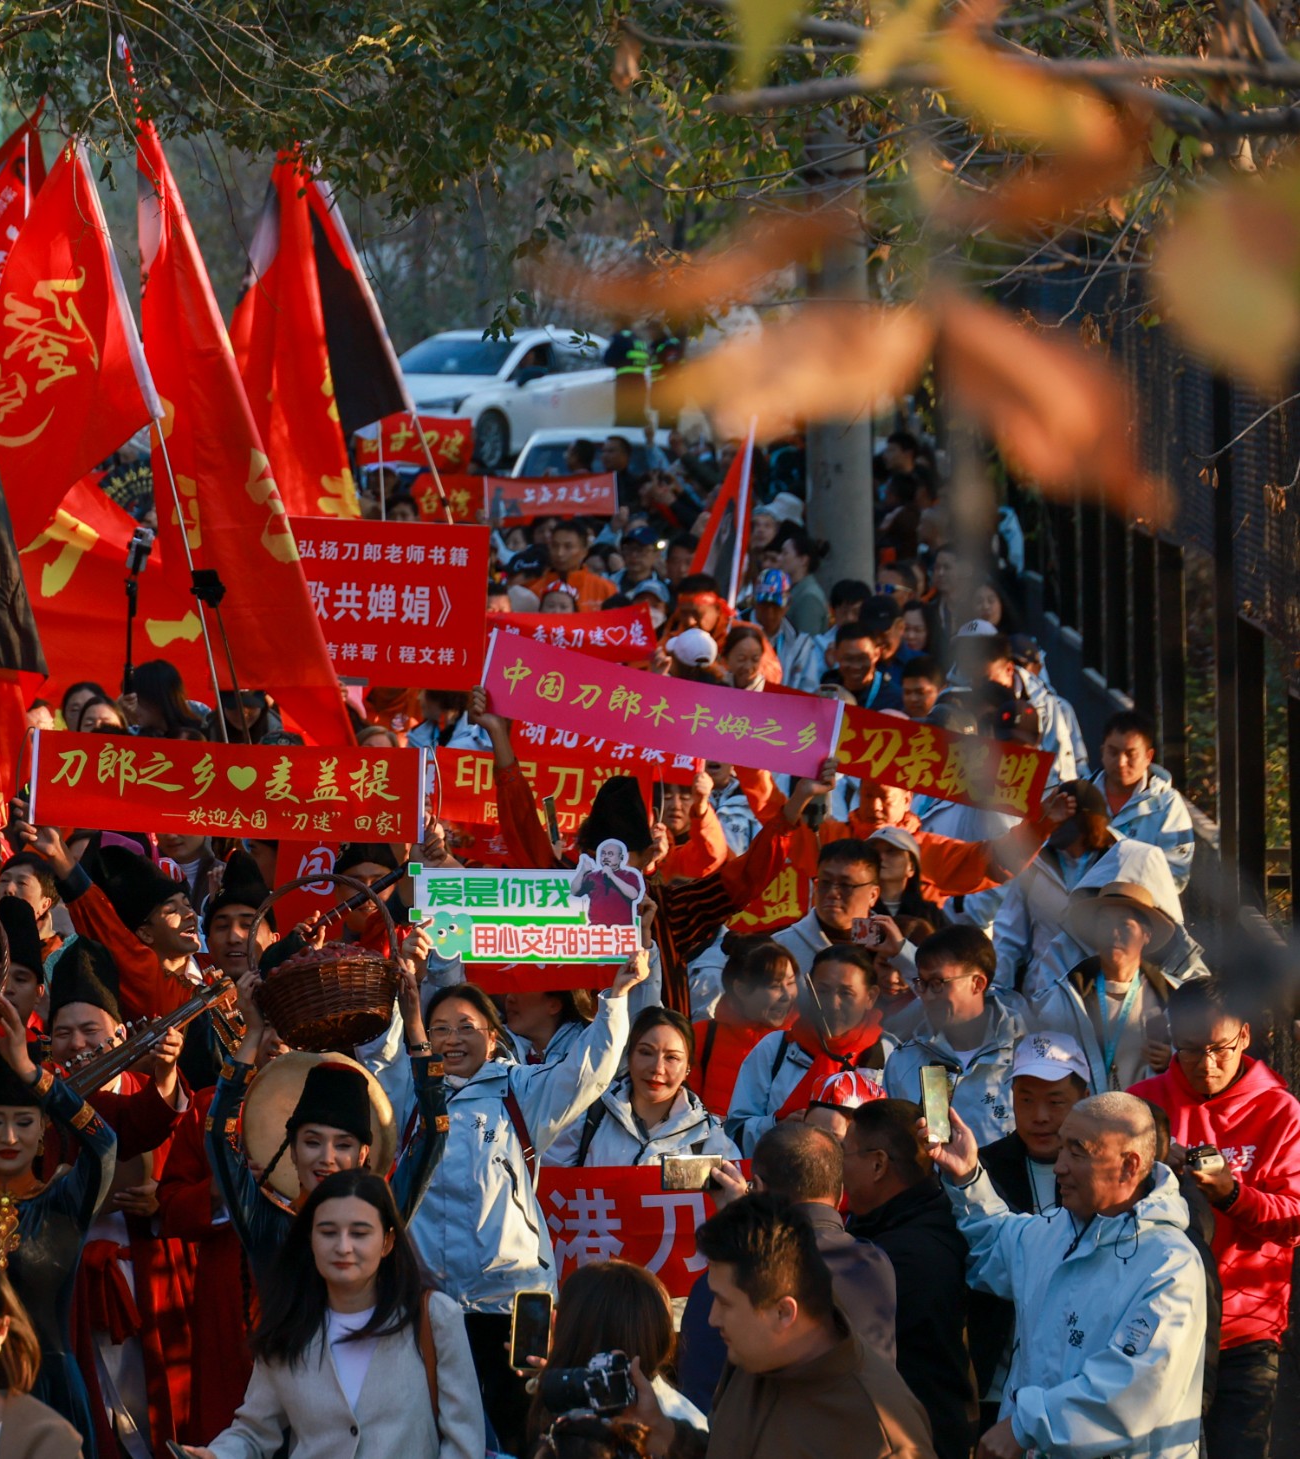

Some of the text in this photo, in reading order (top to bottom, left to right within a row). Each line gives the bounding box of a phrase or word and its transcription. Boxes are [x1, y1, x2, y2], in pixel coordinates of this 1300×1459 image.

[298, 539, 469, 567] 弘扬刀郎老师书籍
[502, 657, 819, 754] 中国刀郎木卡姆之乡
[51, 741, 217, 801] 刀郎之乡
[265, 755, 401, 804] 麦盖提
[427, 876, 571, 909] 爱是你我
[473, 925, 637, 956] 用心交织的生活
